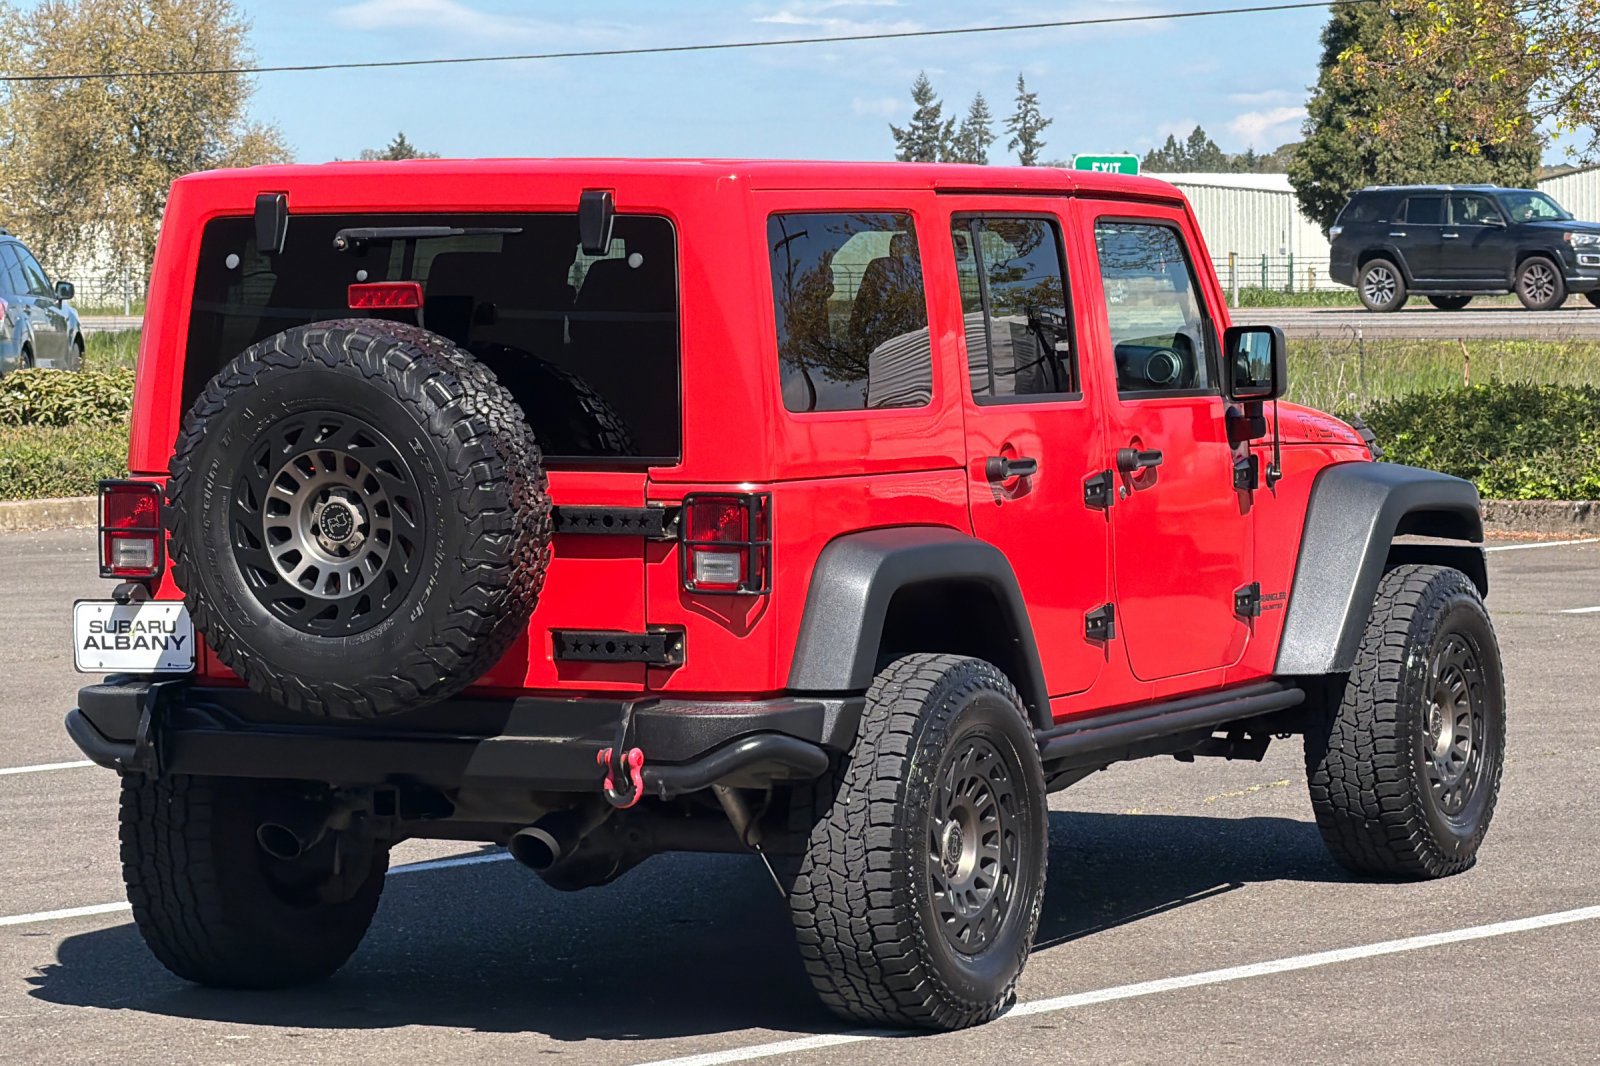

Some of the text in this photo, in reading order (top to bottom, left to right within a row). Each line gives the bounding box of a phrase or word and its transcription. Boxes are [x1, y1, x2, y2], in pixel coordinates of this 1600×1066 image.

[1091, 162, 1121, 174] EXIT
[89, 620, 176, 634] SUBARU
[83, 635, 187, 650] ALBANY
